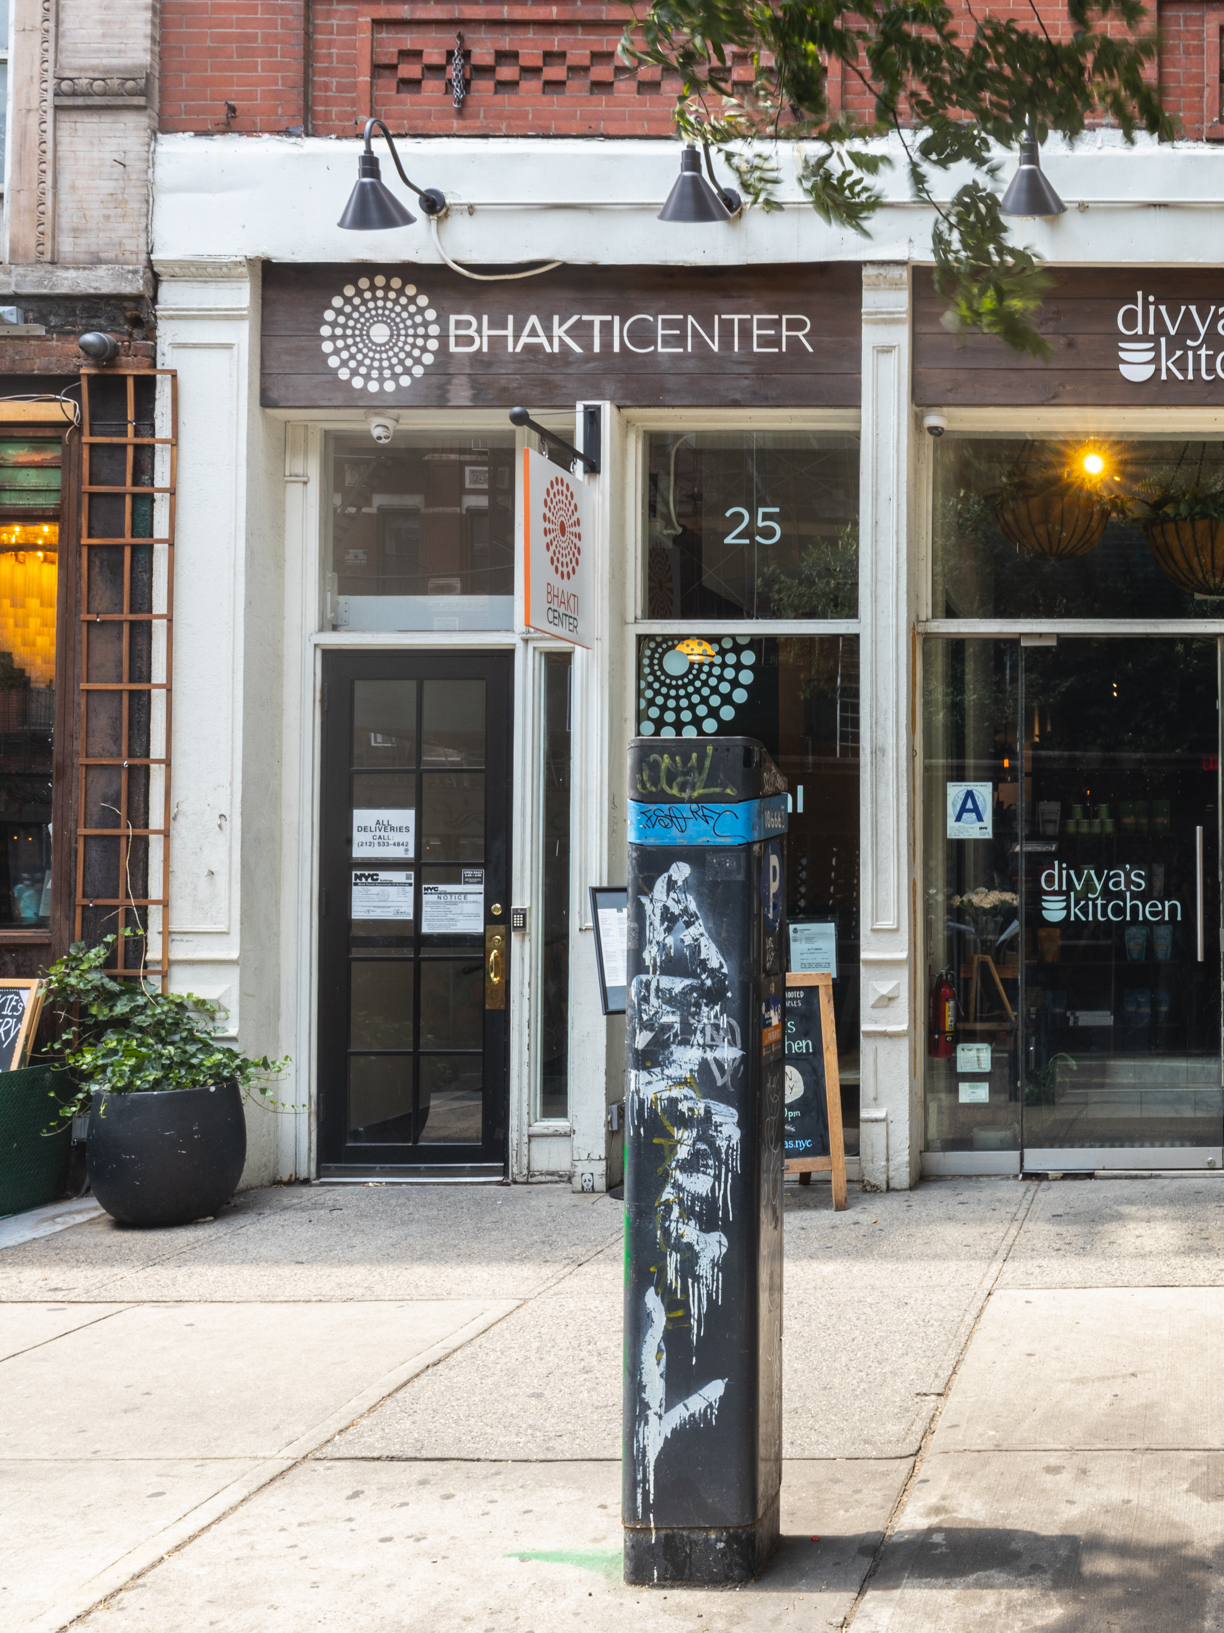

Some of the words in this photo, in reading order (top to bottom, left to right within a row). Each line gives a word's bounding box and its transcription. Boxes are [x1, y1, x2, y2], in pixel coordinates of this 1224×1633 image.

[723, 506, 782, 545] 25
[546, 582, 580, 616] BHAKTI
[546, 607, 580, 635] CENTER
[1202, 756, 1218, 771] EXI
[954, 789, 985, 823] A
[354, 872, 380, 882] NYC
[769, 854, 780, 919] P
[1041, 860, 1146, 898] divya's
[1070, 891, 1182, 922] kitchen
